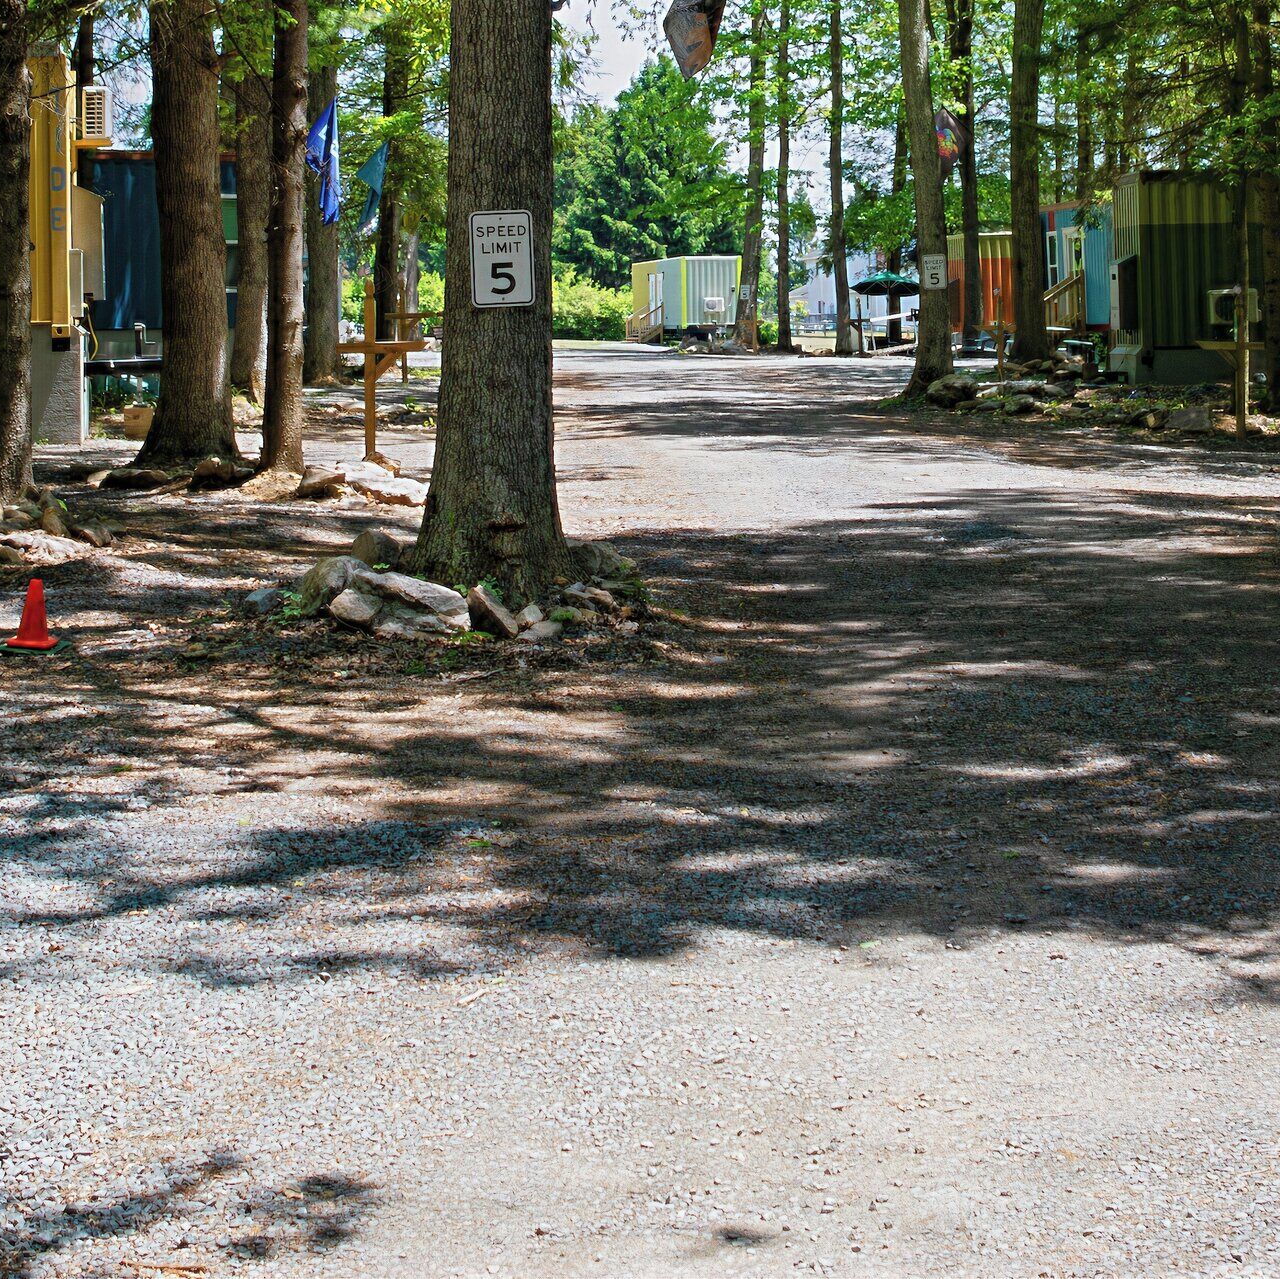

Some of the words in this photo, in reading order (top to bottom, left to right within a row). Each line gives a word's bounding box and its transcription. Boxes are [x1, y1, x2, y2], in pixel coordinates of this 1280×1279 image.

[476, 225, 526, 238] SPEED
[481, 242, 522, 254] LIMIT
[491, 262, 516, 295] 5
[931, 273, 940, 285] 5
